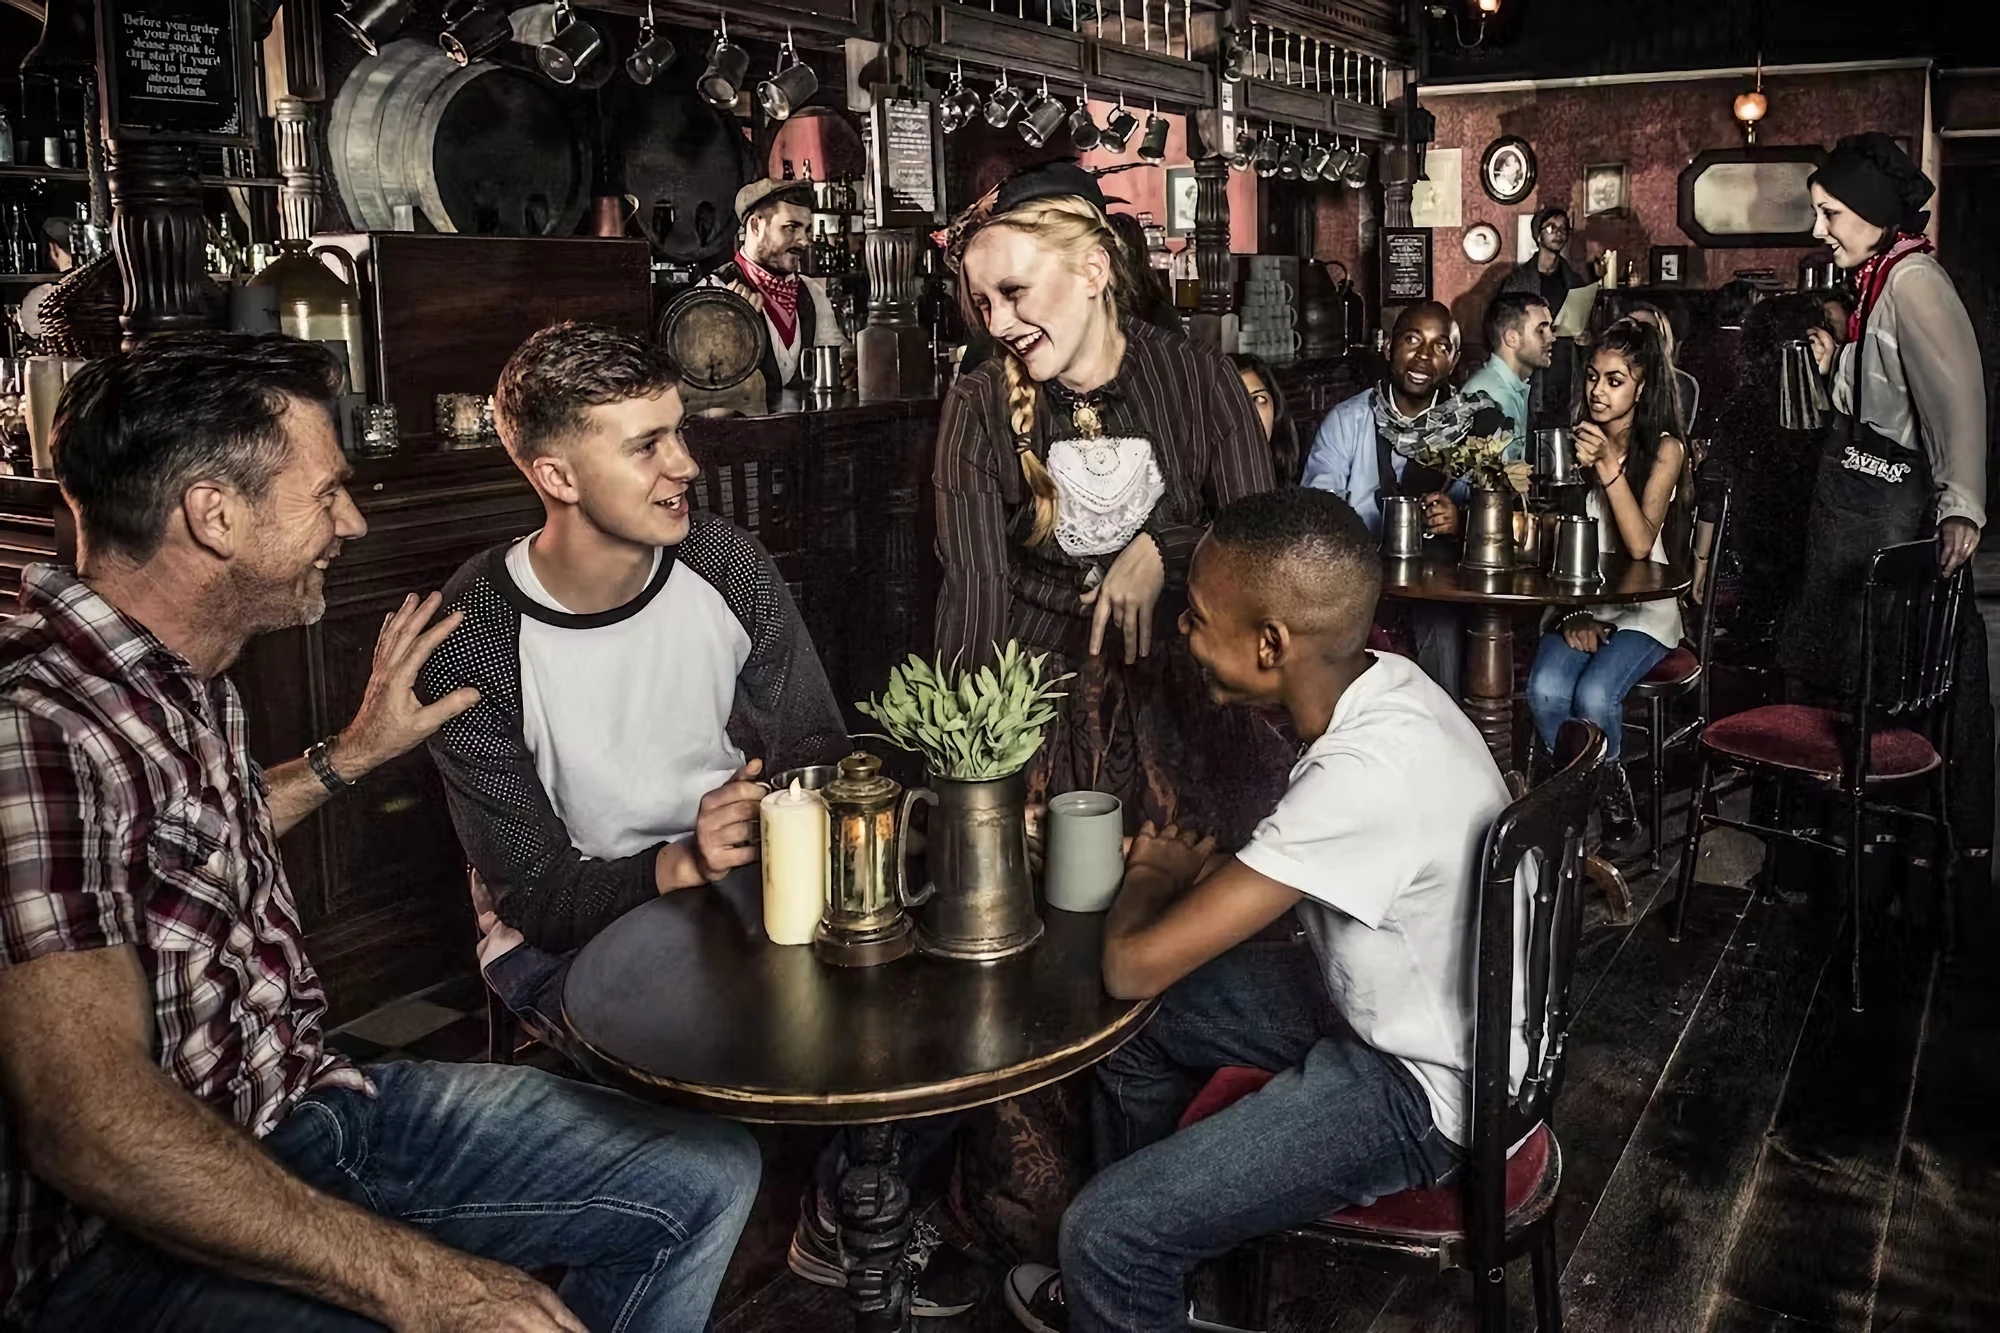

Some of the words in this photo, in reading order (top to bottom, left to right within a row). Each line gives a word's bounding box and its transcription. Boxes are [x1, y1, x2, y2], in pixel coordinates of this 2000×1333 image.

[122, 13, 162, 28] Before
[190, 24, 220, 35] order
[143, 29, 170, 40] your
[168, 43, 201, 54] speak
[204, 45, 215, 55] to
[149, 51, 175, 62] staff
[179, 53, 187, 63] if
[140, 59, 161, 71] like
[164, 62, 176, 72] to
[179, 63, 208, 75] know
[148, 72, 180, 84] about
